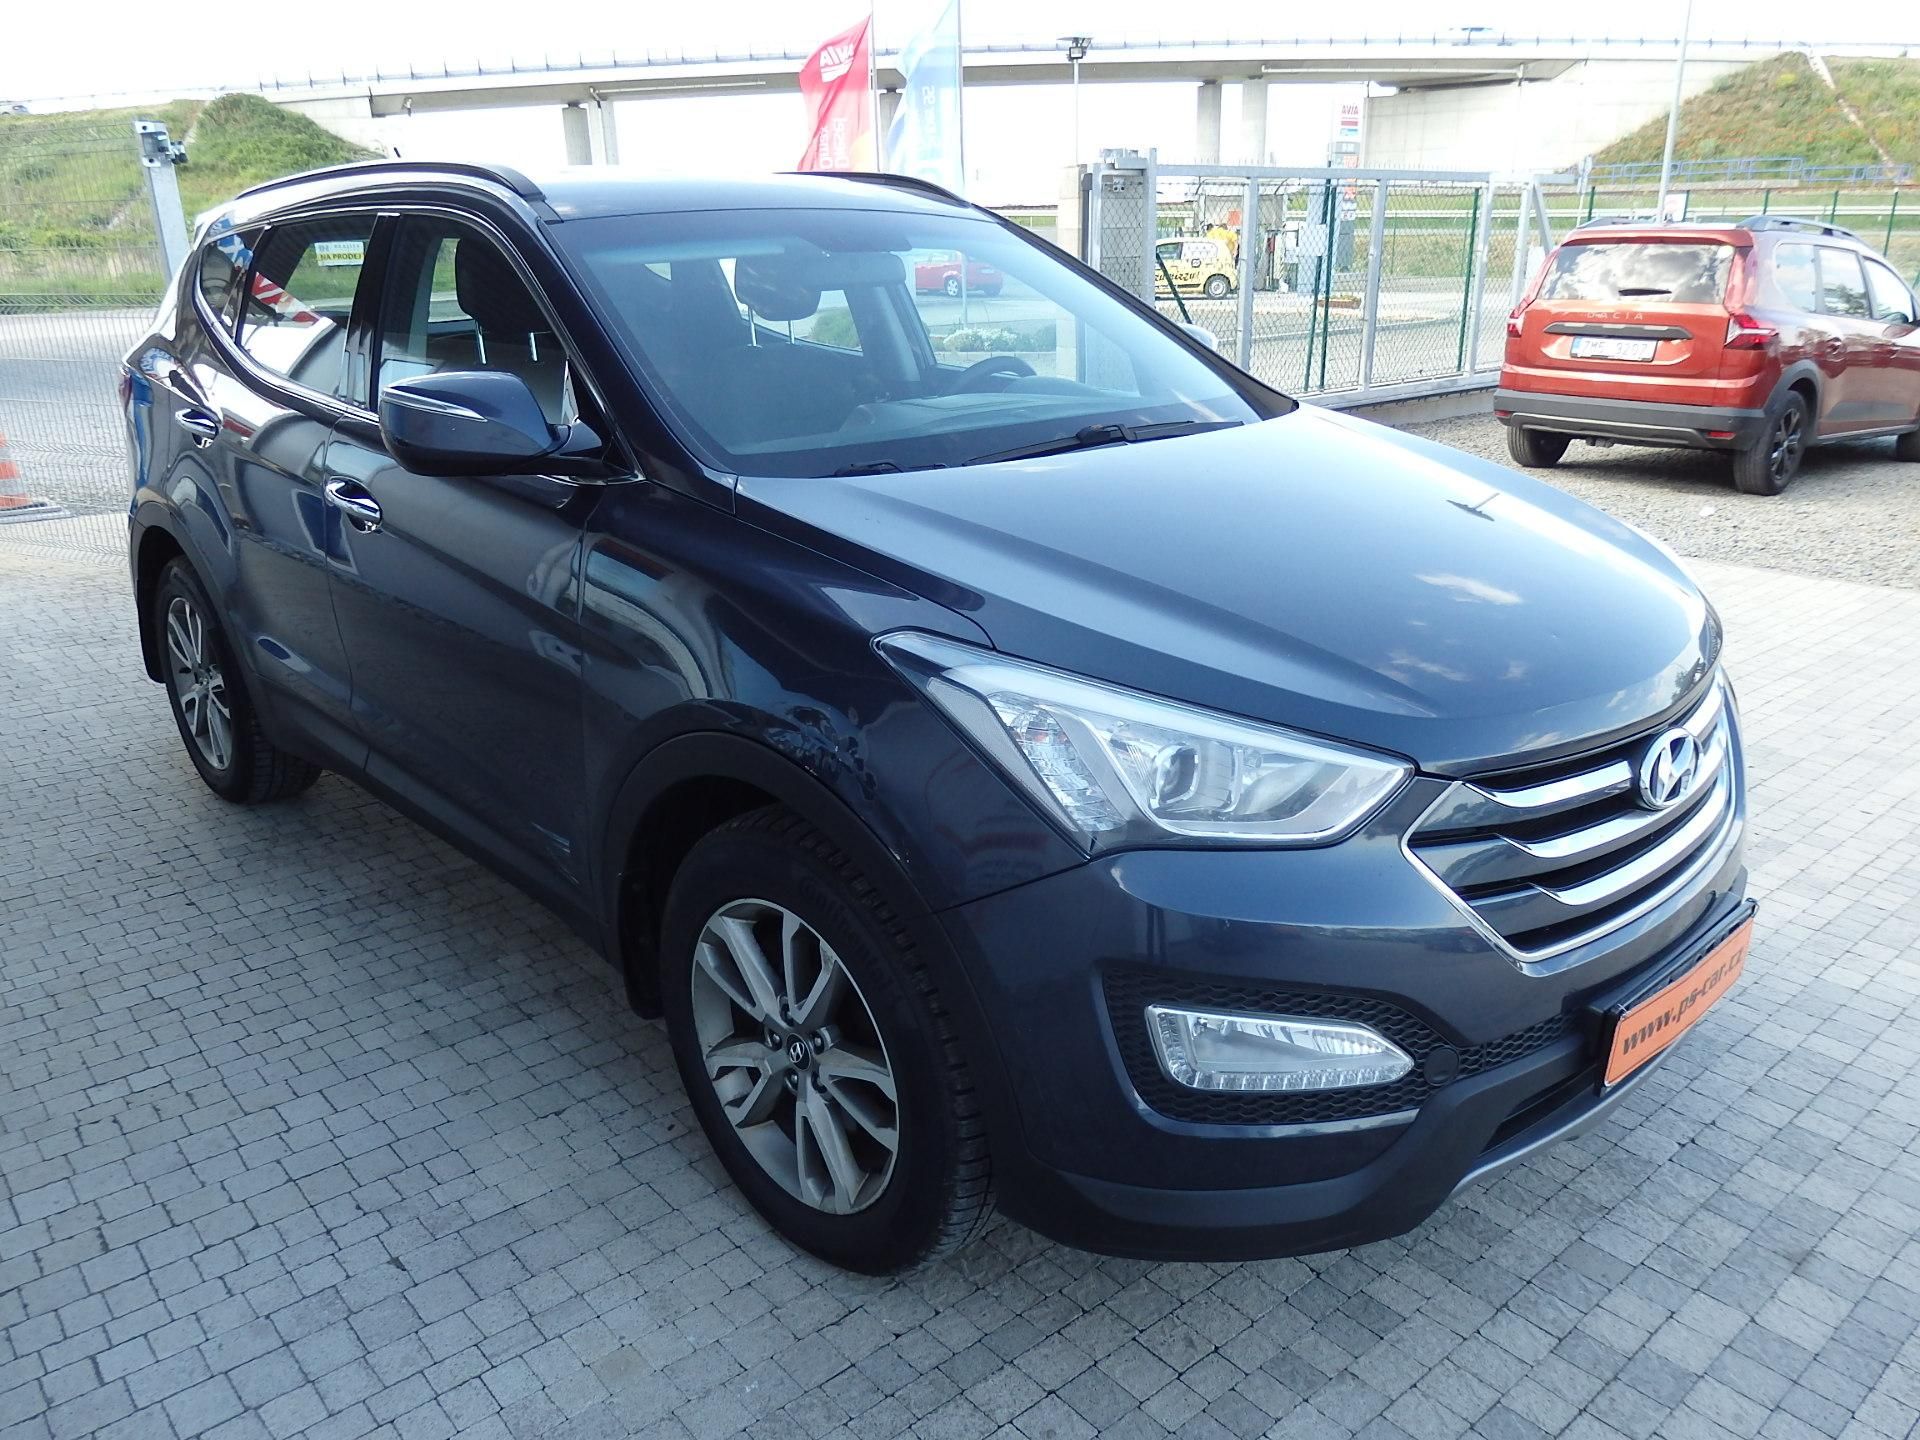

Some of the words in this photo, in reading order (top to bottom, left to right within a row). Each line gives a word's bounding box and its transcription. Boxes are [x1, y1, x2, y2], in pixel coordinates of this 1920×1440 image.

[1341, 104, 1359, 116] AVIA
[1586, 312, 1643, 320] DACIA
[1622, 946, 1743, 1056] www.ps-car.cz
